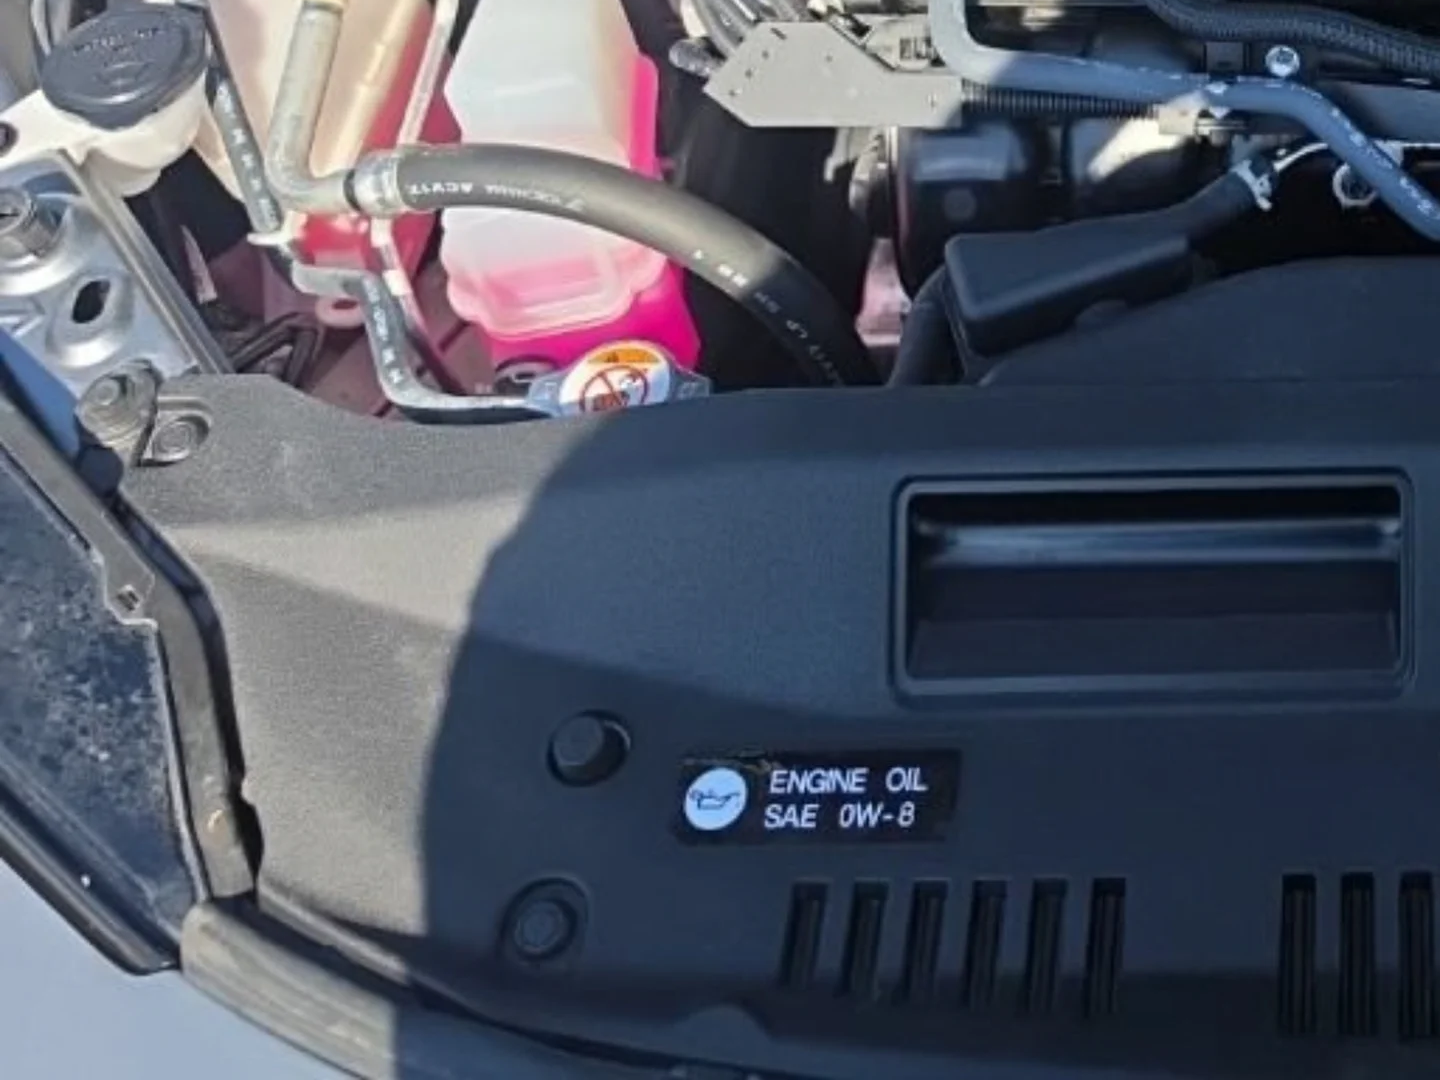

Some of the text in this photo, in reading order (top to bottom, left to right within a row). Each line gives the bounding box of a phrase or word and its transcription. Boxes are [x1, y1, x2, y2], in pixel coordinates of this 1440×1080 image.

[768, 766, 930, 795] ENGINE OIL
[763, 800, 916, 829] SAE 0W-8
